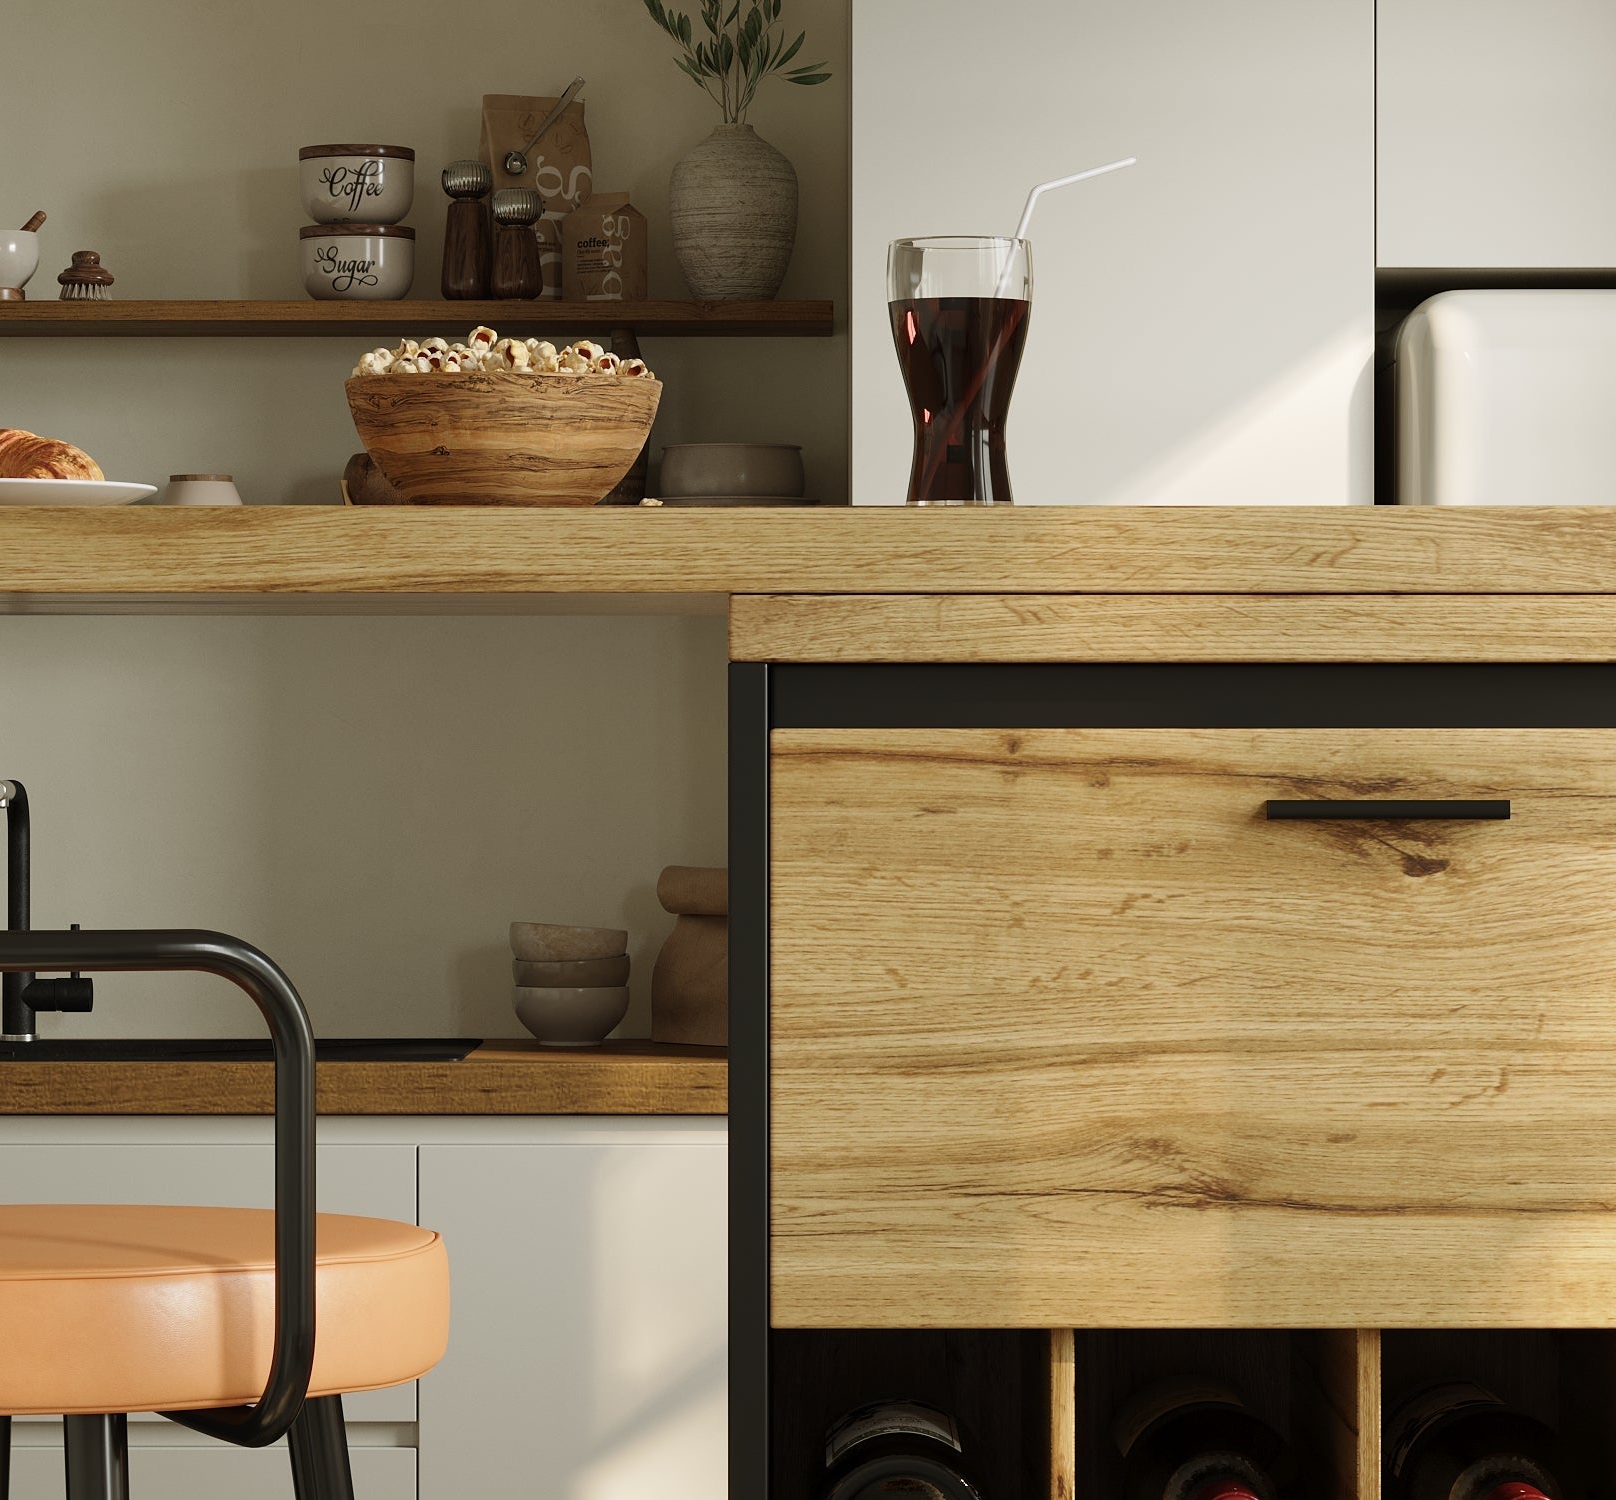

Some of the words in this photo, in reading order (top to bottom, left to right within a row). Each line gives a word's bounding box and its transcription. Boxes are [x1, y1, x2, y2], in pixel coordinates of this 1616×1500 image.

[318, 160, 384, 212] Coffee
[314, 245, 379, 292] Sugar
[586, 214, 631, 301] bag
